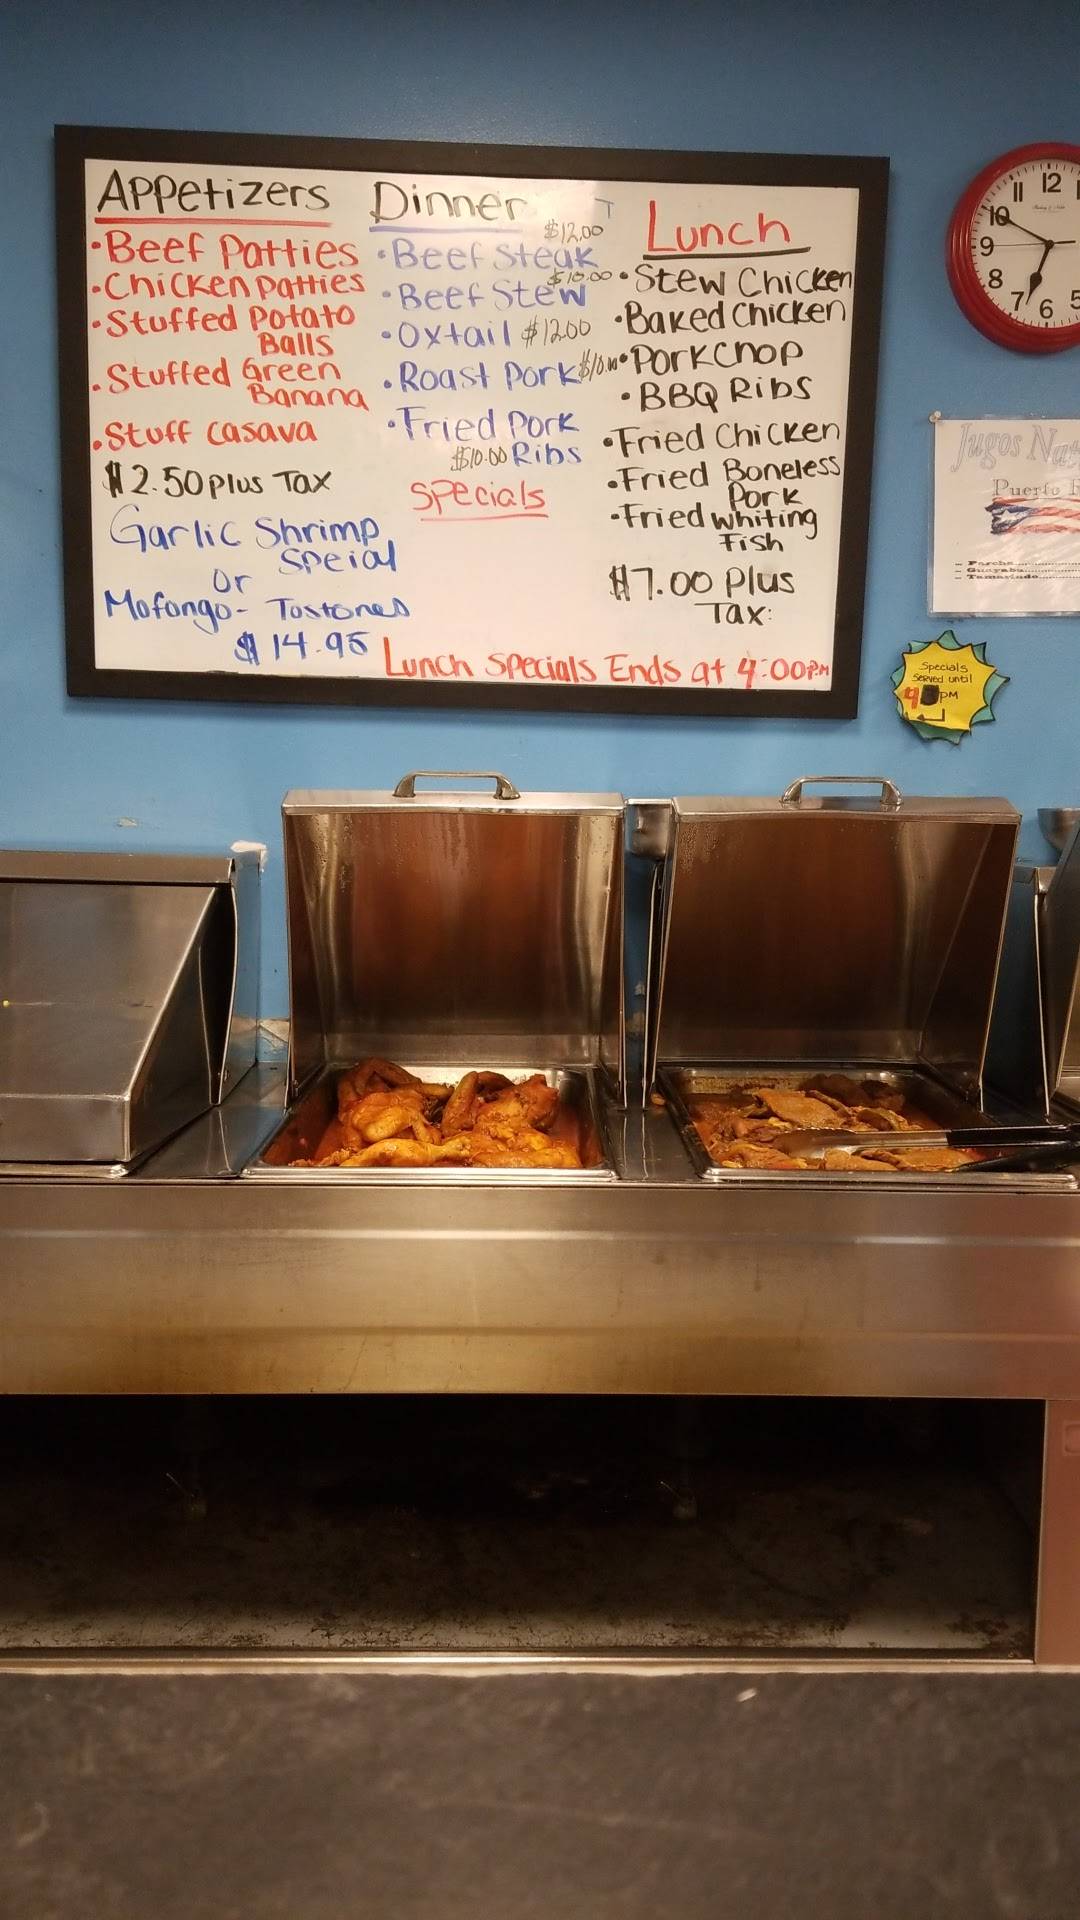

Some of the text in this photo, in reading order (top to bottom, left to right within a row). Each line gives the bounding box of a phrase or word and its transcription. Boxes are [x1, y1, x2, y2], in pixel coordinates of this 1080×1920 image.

[1013, 181, 1023, 202] 11
[1042, 172, 1062, 193] 12
[369, 181, 527, 223] Dinner
[989, 205, 1010, 226] 10
[647, 200, 791, 252] Lunch
[105, 230, 359, 269] Beef Patties
[392, 238, 598, 270] Beef Steak
[980, 236, 994, 257] 9
[104, 272, 250, 300] Chicken
[635, 263, 852, 297] Stew Chicken
[988, 268, 1003, 289] 8
[399, 279, 586, 311] Beef Stew
[1011, 291, 1024, 311] 7
[1039, 299, 1054, 319] 6
[106, 304, 238, 337] Stuffed
[625, 300, 725, 334] Baked
[258, 332, 334, 356] Balls
[399, 320, 511, 349] Oxtail
[107, 357, 341, 393] Stuffed Green
[400, 361, 490, 392] Roast
[248, 383, 369, 411] Banana
[640, 376, 812, 413] BBQ Ribs
[104, 420, 192, 450] Stuff
[396, 406, 496, 441] Fried
[512, 441, 582, 466] Ribs
[610, 422, 840, 458] Fried Chicken
[951, 422, 1023, 473] Jugos
[272, 470, 331, 493] Tax
[616, 456, 841, 491] Fried Boneless
[992, 479, 1060, 496] Puerto
[728, 481, 803, 511] Pork
[109, 503, 379, 552] Garlic Shrimp
[617, 501, 705, 529] Fried
[718, 532, 784, 552] Fish
[609, 564, 713, 601] $7.00
[265, 597, 410, 621] Tostones
[383, 636, 474, 678] Lunch
[604, 654, 681, 686] Ends
[691, 658, 725, 688] at
[920, 661, 968, 674] Specials
[948, 674, 972, 683] until
